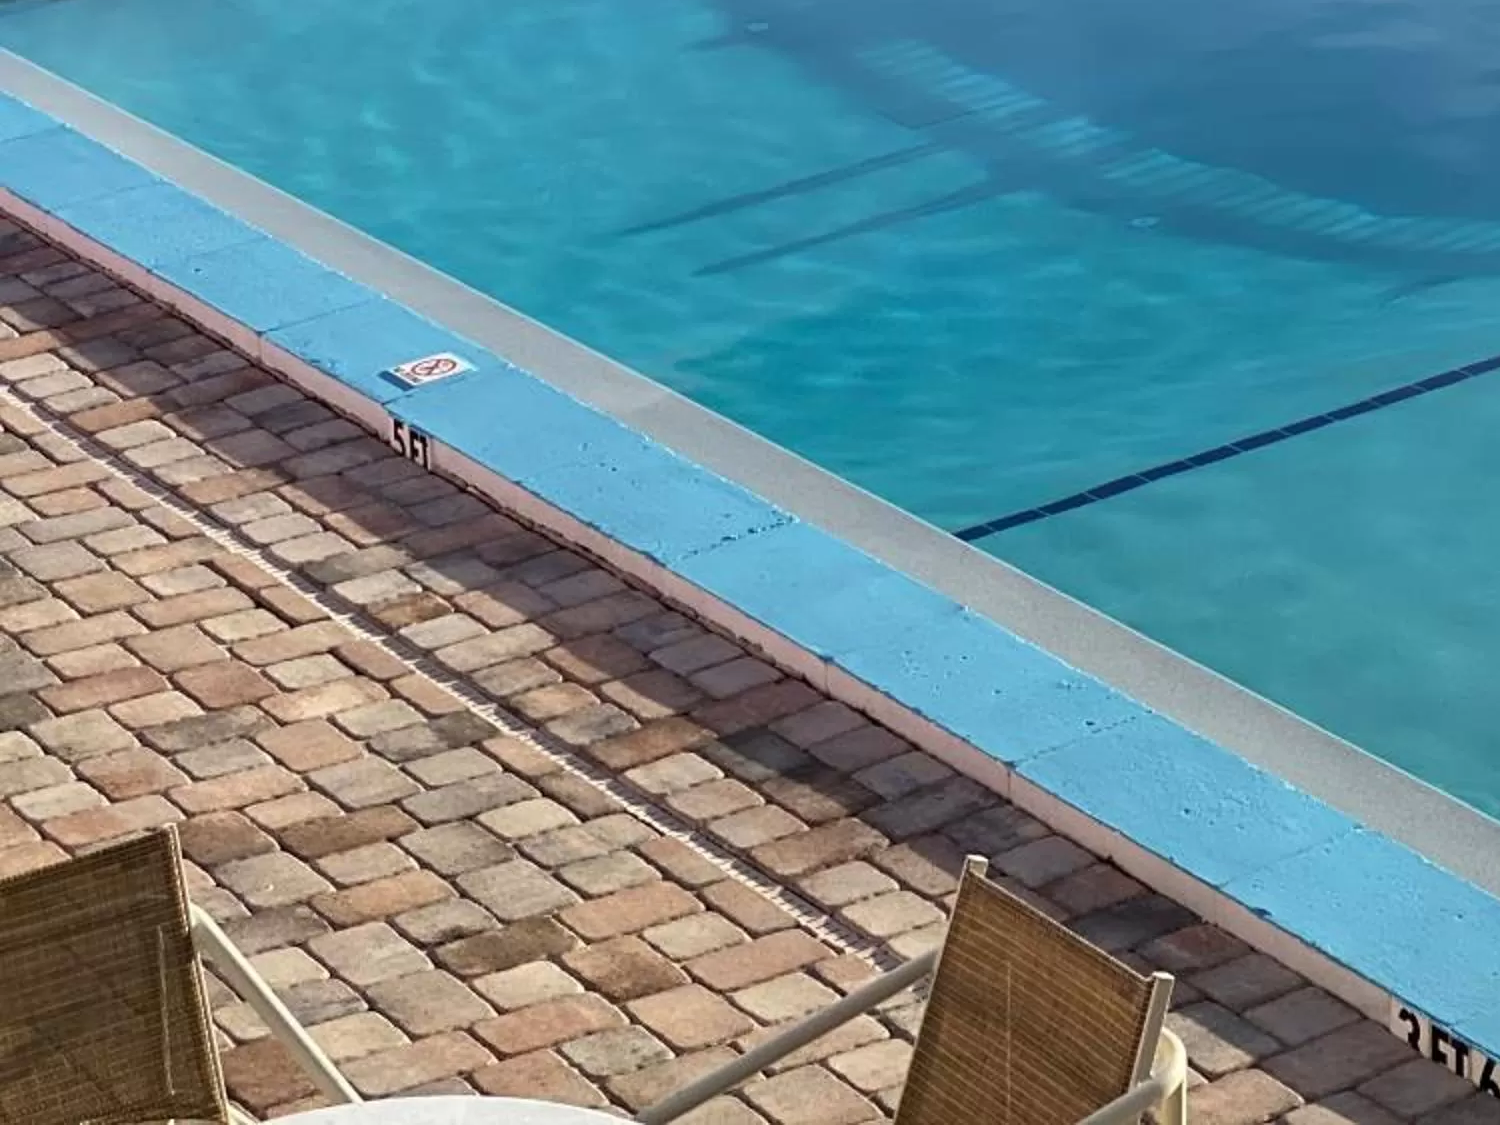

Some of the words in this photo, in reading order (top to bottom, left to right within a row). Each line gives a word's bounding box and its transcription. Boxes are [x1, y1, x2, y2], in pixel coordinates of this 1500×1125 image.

[393, 419, 406, 457] 5
[410, 430, 429, 470] FT
[1398, 1008, 1421, 1053] 3
[1432, 1024, 1470, 1078] FT
